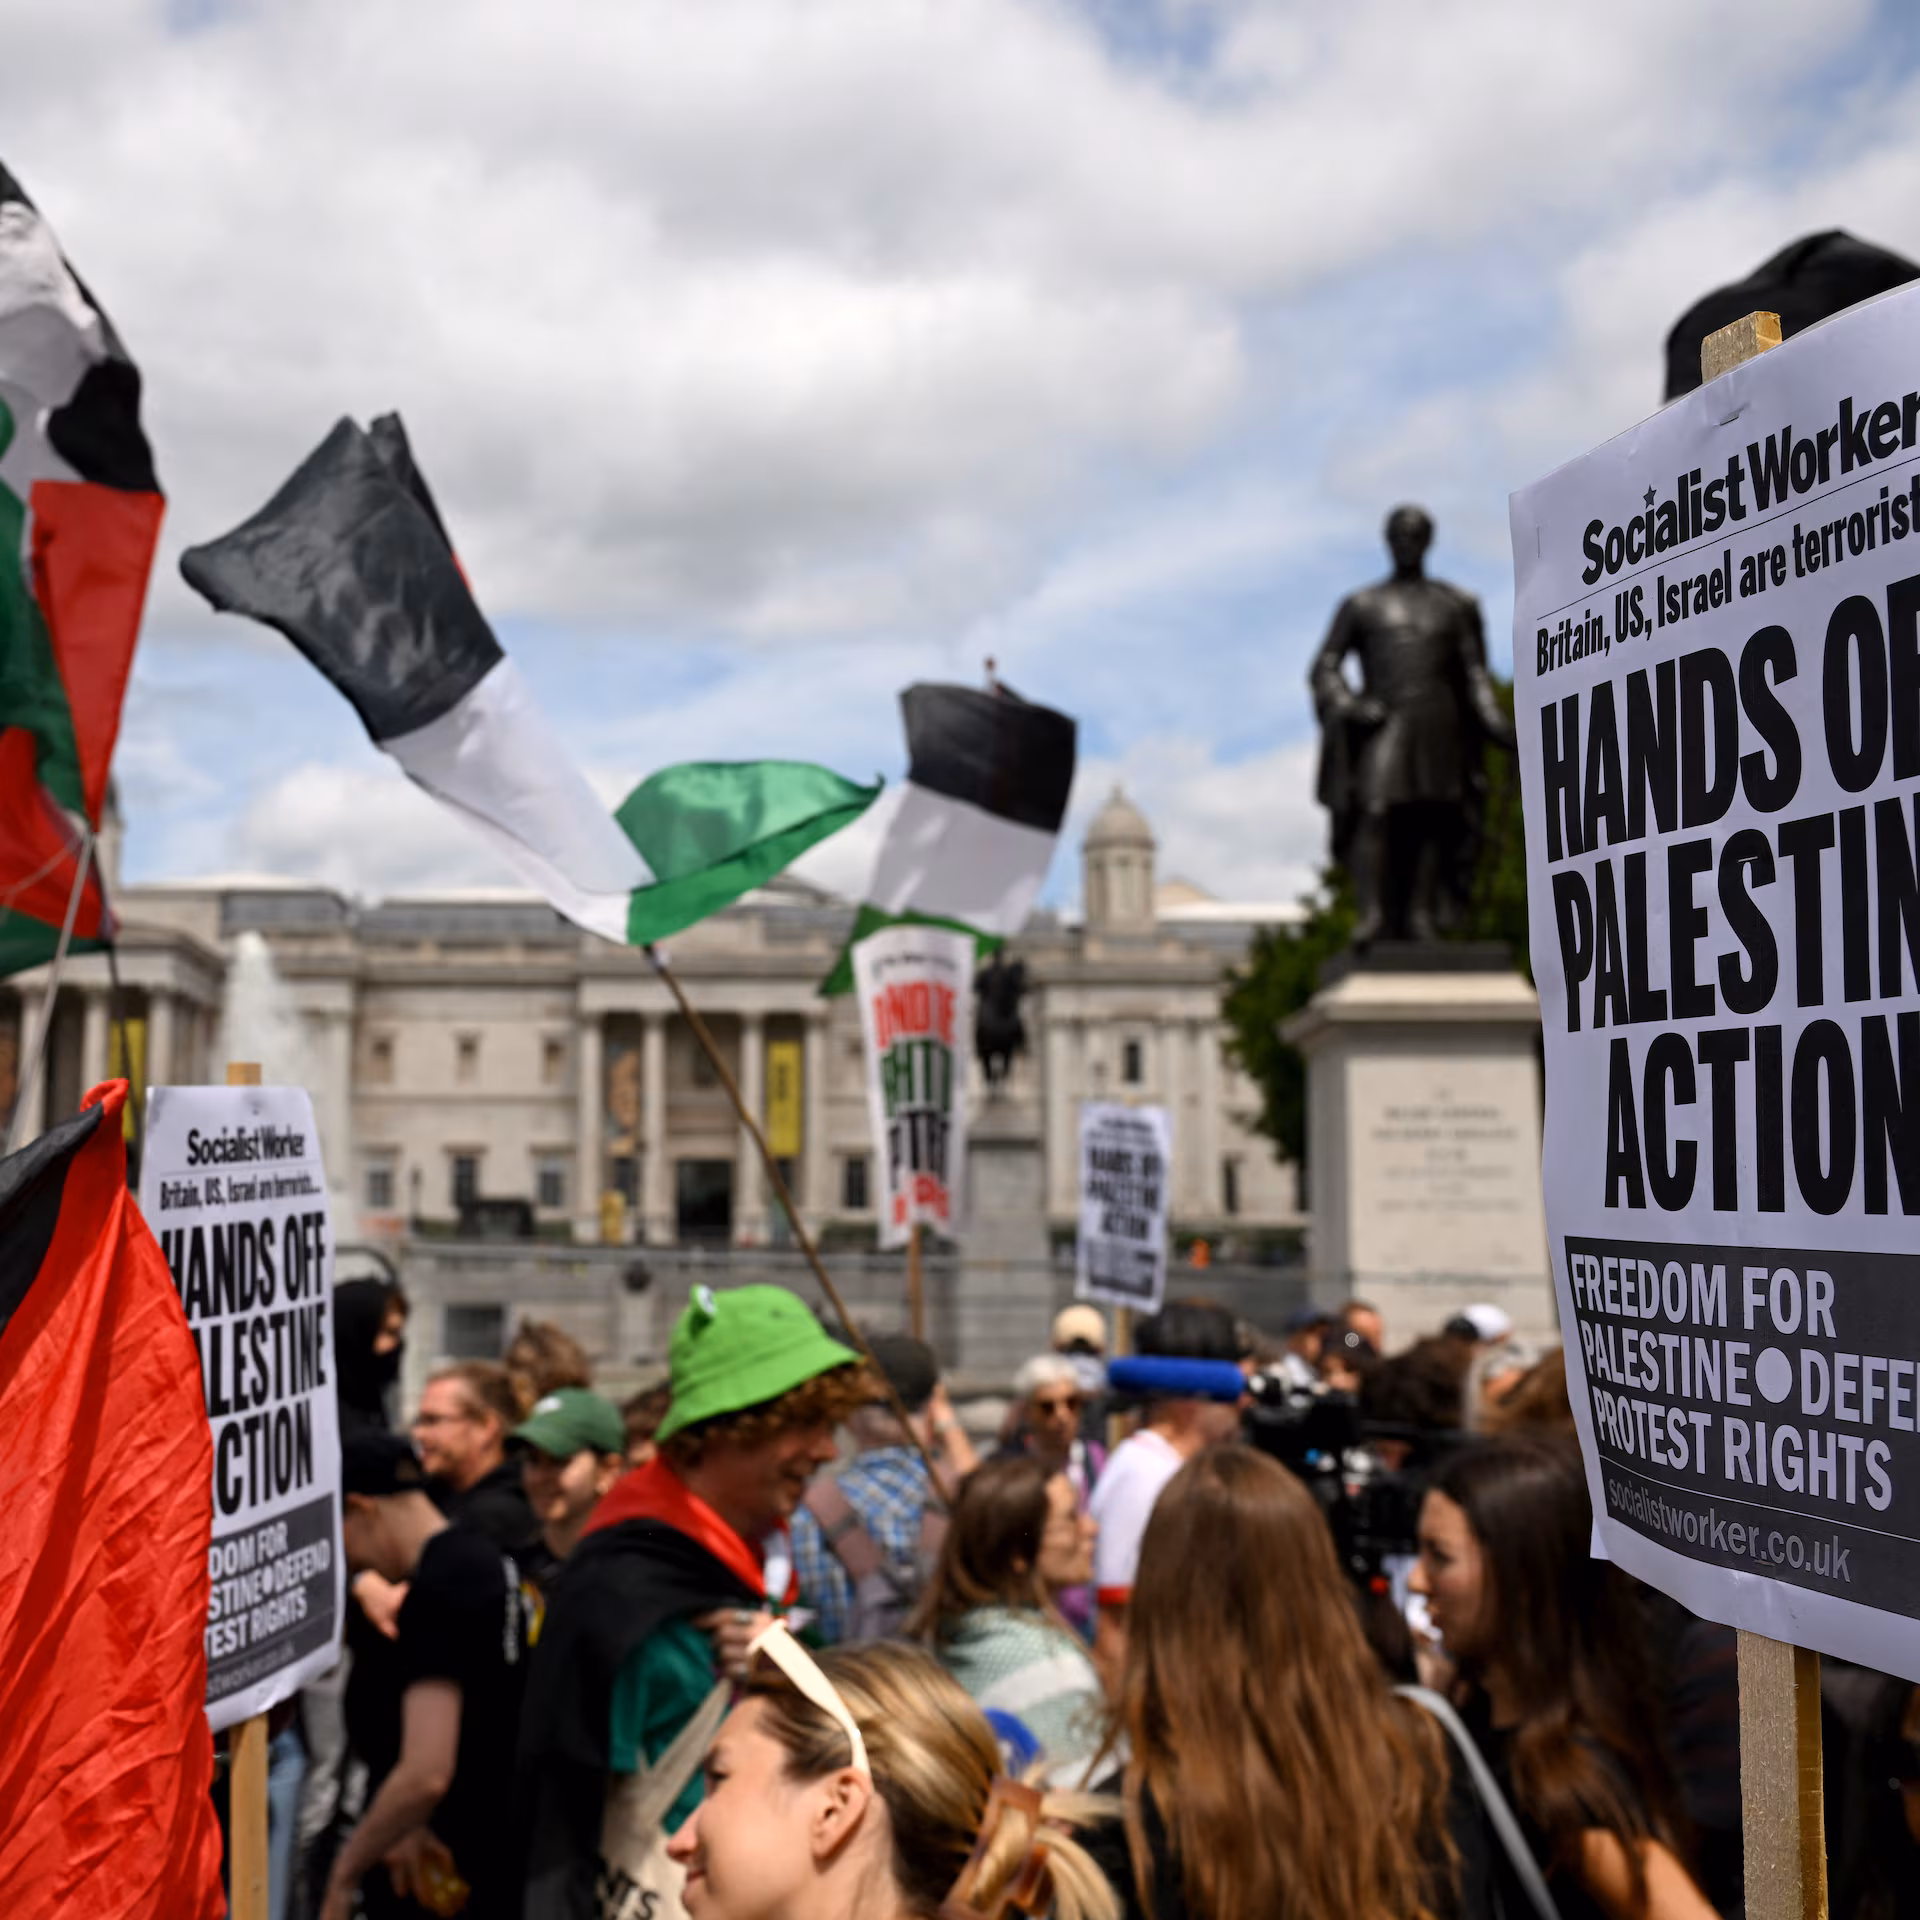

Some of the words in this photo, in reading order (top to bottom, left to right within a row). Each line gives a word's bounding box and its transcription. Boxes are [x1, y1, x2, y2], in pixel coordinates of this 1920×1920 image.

[1582, 454, 1747, 586] Socialist
[1746, 391, 1920, 512] Worker
[1536, 608, 1611, 676] Britain,
[1614, 585, 1652, 643] US,
[1657, 549, 1732, 628] Israel
[1740, 544, 1786, 598] are
[1541, 625, 1801, 862] HANDS
[187, 1126, 260, 1166] Socialist
[261, 1124, 305, 1160] Worker
[1605, 1010, 1920, 1216] ACTION
[160, 1179, 202, 1211] Britain,
[205, 1176, 226, 1206] US,
[227, 1174, 257, 1204] Israel
[283, 1211, 325, 1301] OFF
[1570, 1253, 1728, 1328] FREEDOM
[1742, 1266, 1837, 1339] FOR
[1580, 1319, 1752, 1407] PALESTINE
[1799, 1348, 1920, 1433] DEFE
[213, 1398, 314, 1516] CTION
[1592, 1385, 1712, 1475] PROTEST
[1723, 1416, 1893, 1512] RIGHTS
[257, 1521, 288, 1563] FOR
[1608, 1478, 1851, 1583] socialistworker.co.uk
[204, 1613, 249, 1659] TEST
[251, 1585, 308, 1643] RIGHTS
